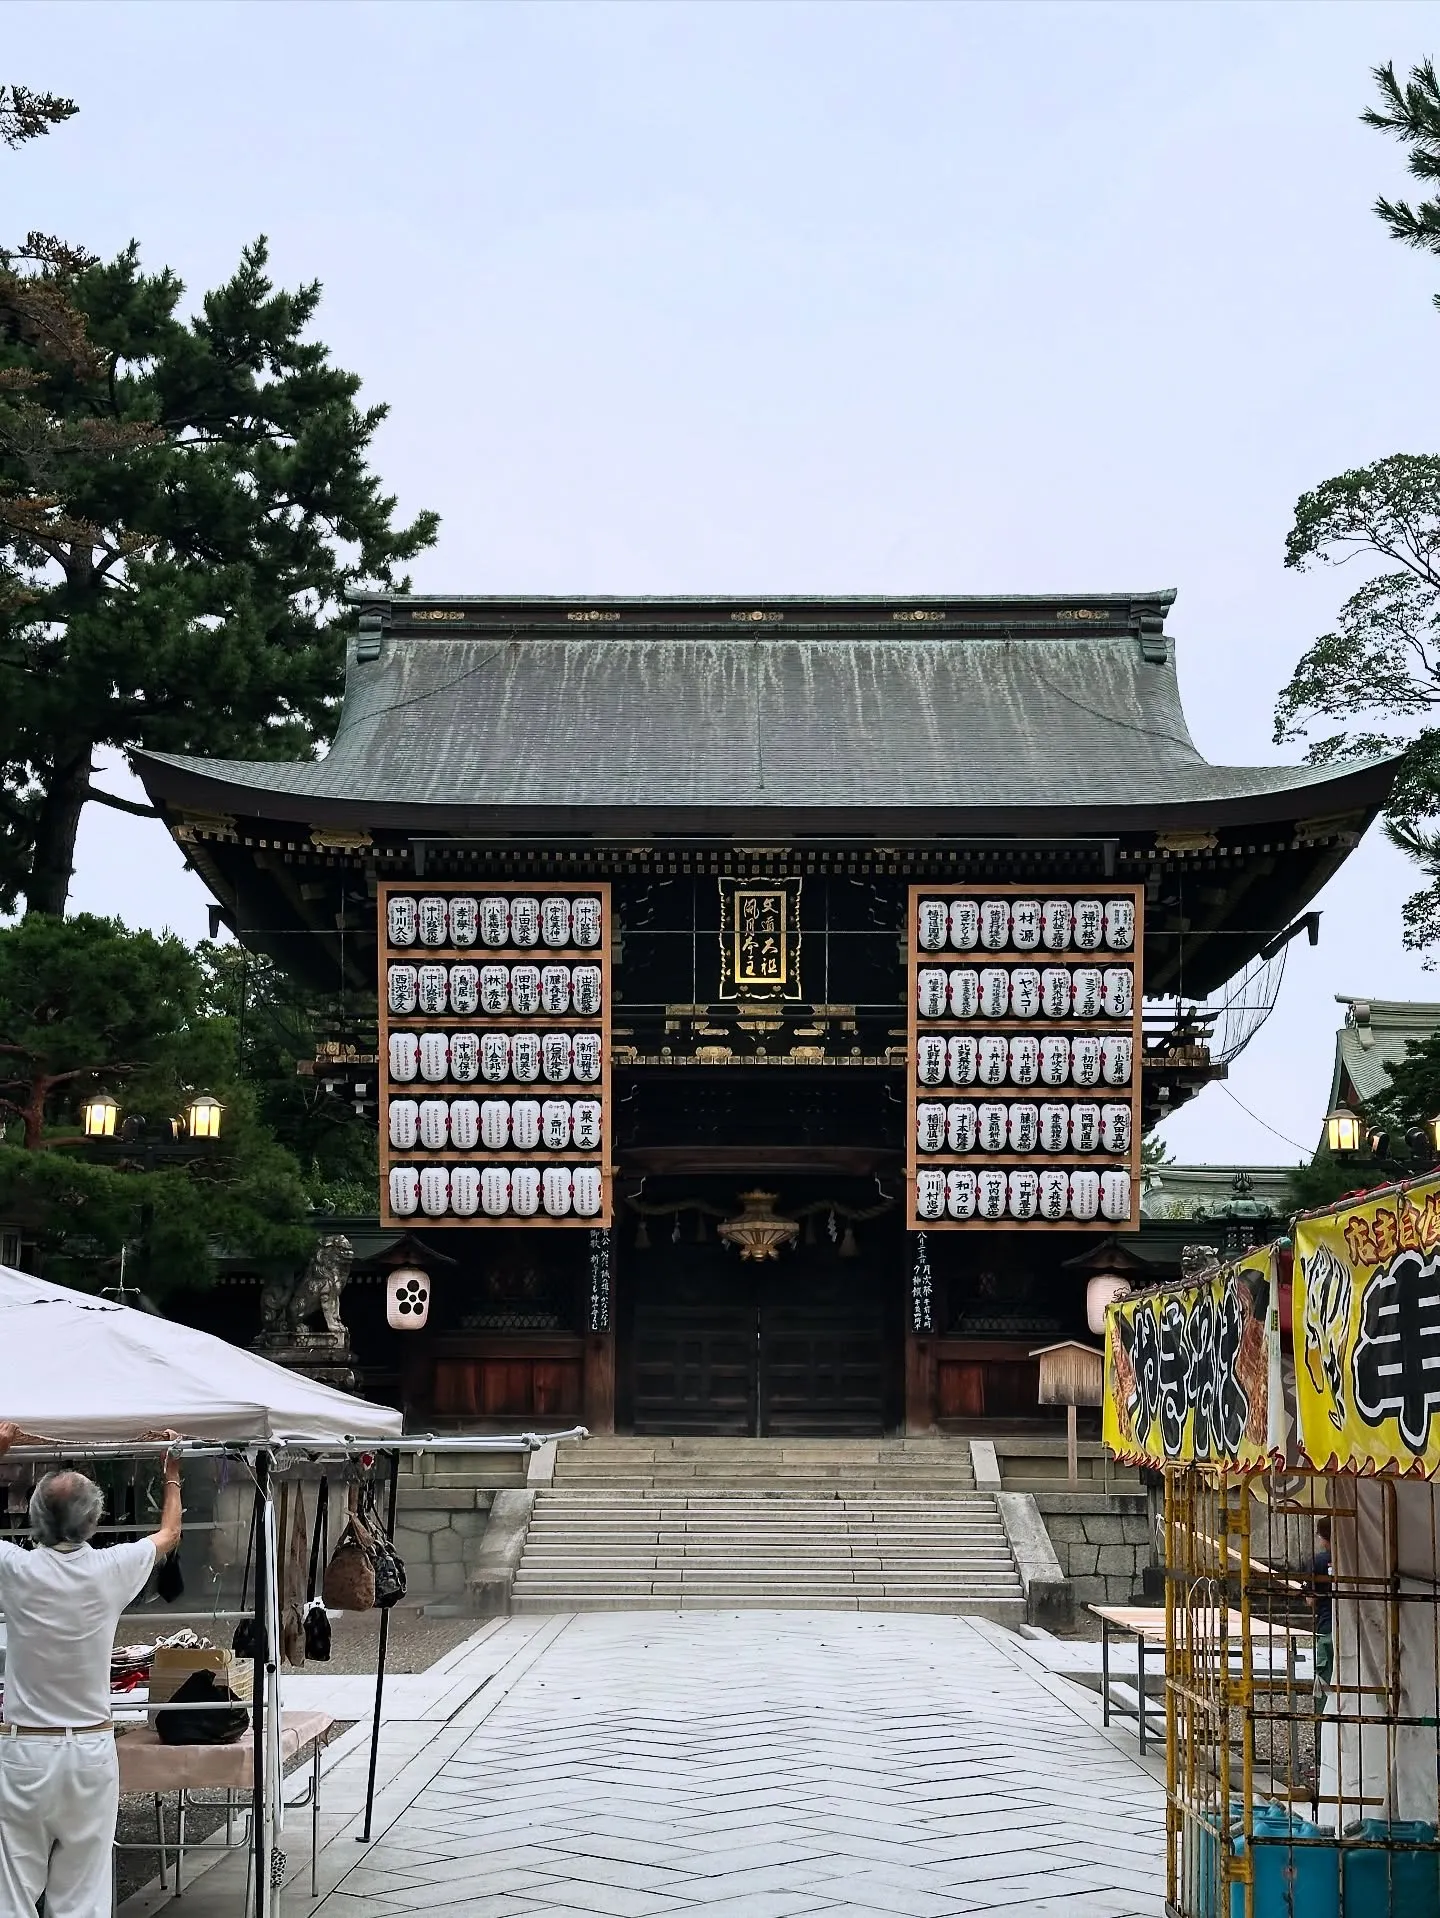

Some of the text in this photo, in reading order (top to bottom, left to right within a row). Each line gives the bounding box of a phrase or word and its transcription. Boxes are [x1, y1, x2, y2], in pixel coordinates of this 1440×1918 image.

[396, 906, 408, 943] 中川久公
[1019, 912, 1035, 943] 材源
[1081, 911, 1096, 947] 福井紙店
[1114, 927, 1128, 947] 老松
[1019, 979, 1033, 1014] ヤギコー
[1113, 994, 1125, 1014] もり
[1050, 1052, 1063, 1083] 伊吹文明
[956, 1181, 970, 1215] 和乃匠
